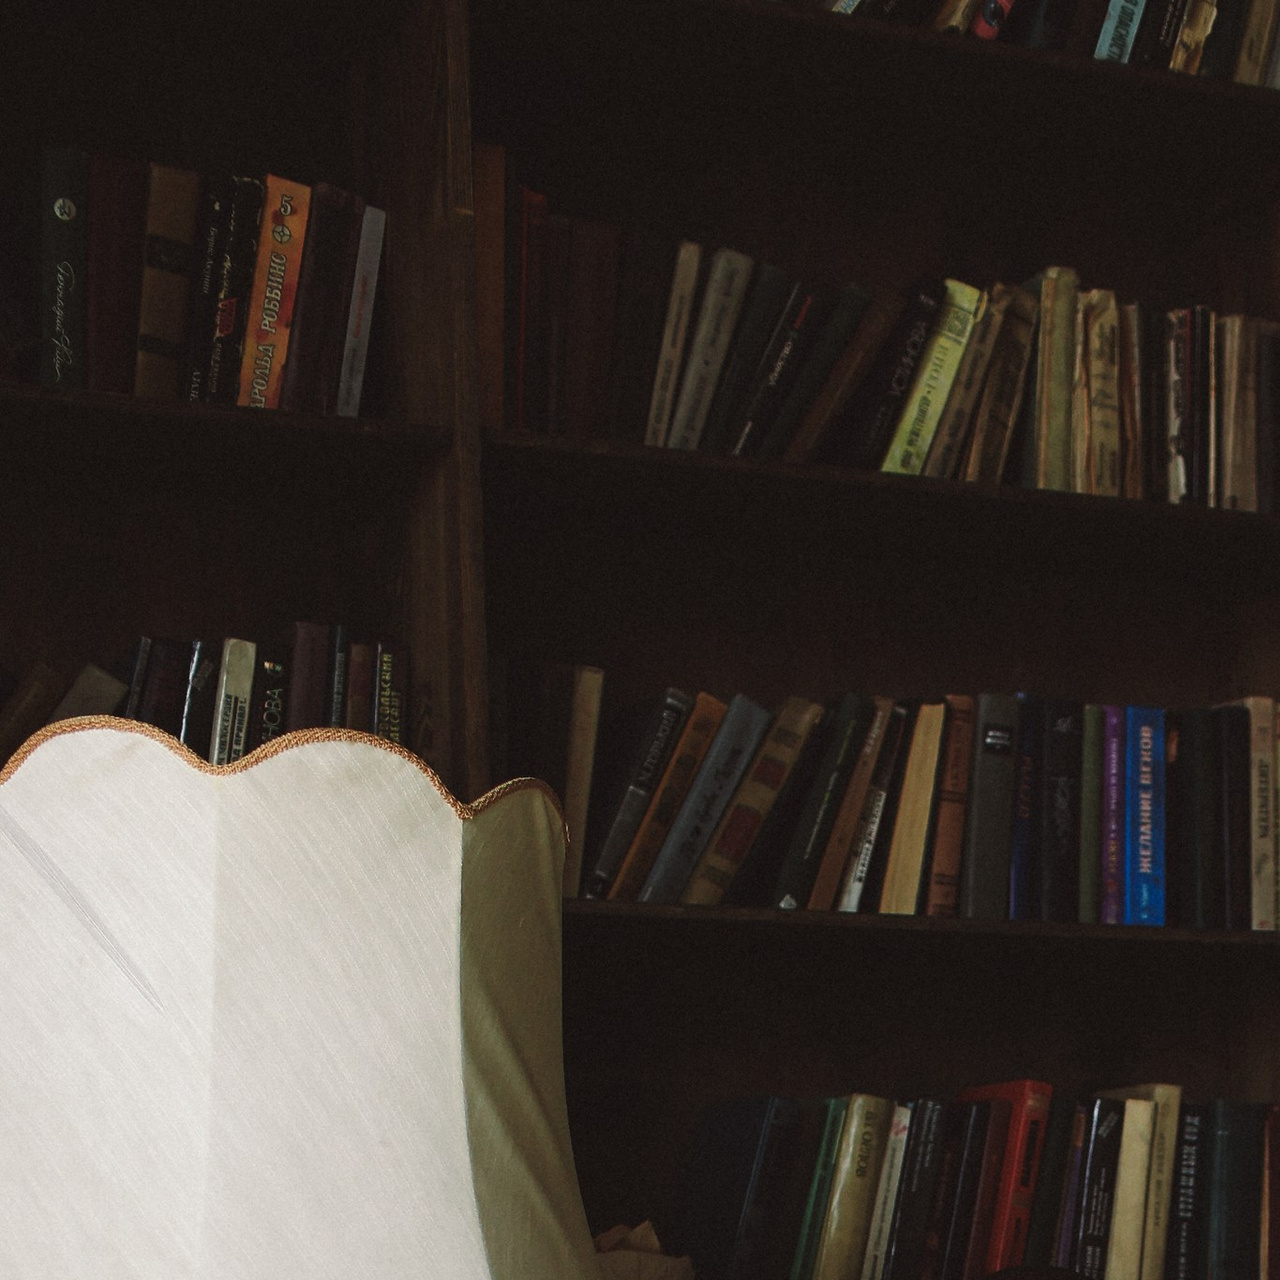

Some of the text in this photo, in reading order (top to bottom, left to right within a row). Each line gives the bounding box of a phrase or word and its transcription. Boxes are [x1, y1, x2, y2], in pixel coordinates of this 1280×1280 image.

[280, 194, 293, 216] 5
[261, 252, 287, 334] РОББИНС
[1138, 724, 1153, 874] ЖЕЛАНИЕ ВЕКОВ
